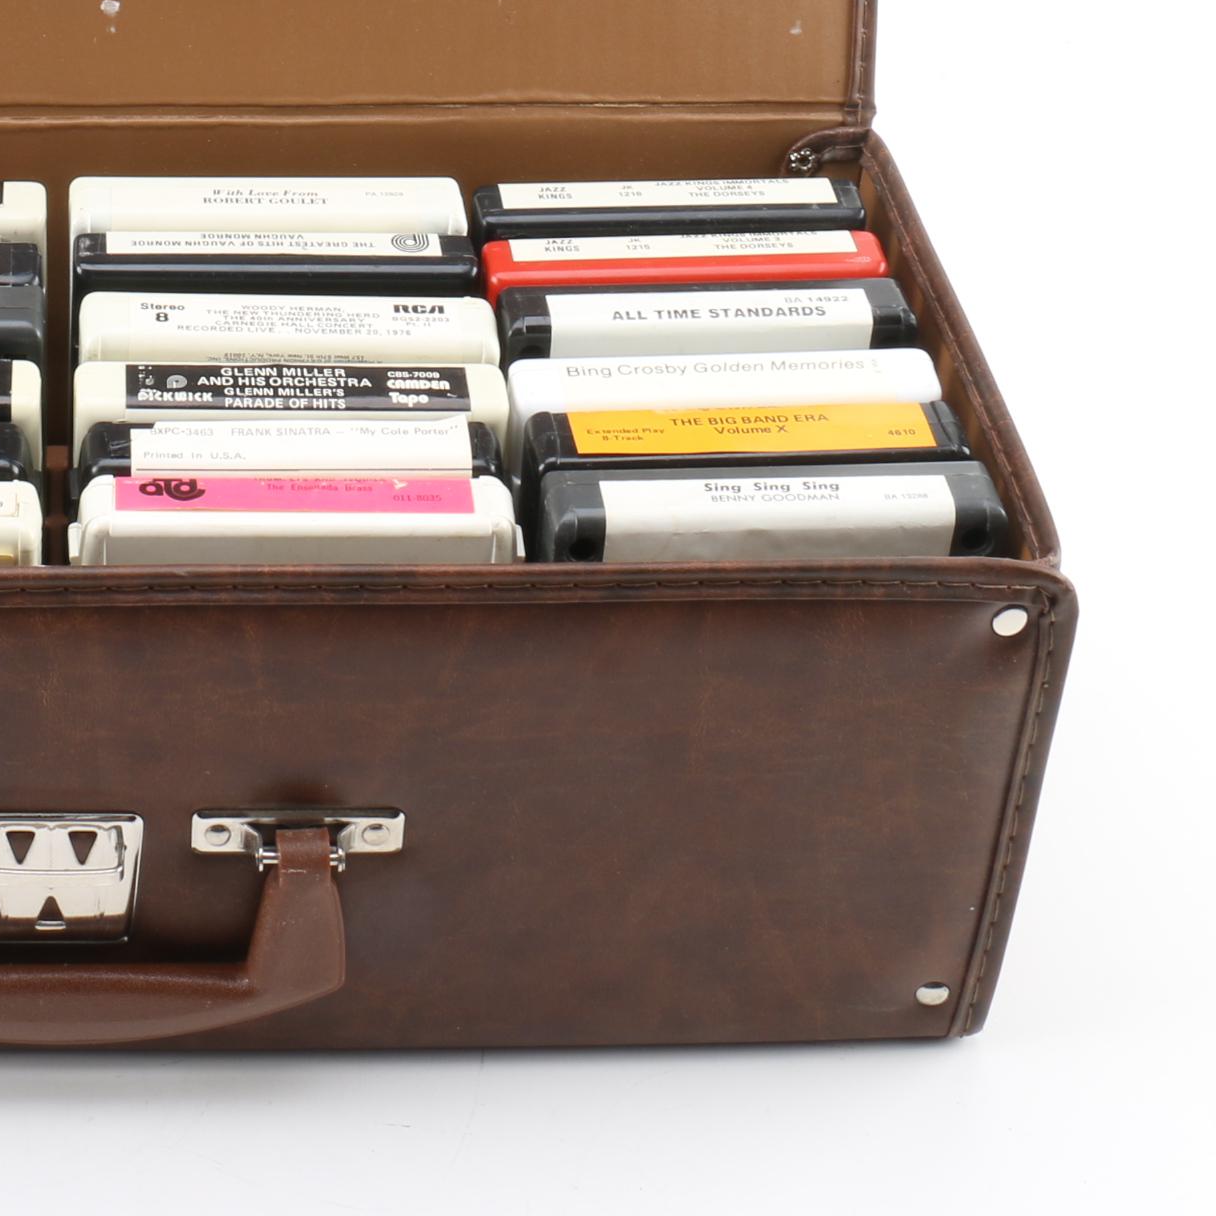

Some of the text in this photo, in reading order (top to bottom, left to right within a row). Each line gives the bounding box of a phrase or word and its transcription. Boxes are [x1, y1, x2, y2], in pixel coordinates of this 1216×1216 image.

[248, 189, 279, 197] Love
[283, 189, 319, 197] From
[269, 197, 329, 205] GOULET
[544, 245, 580, 253] KINGS
[140, 302, 185, 311] Stereo
[393, 304, 445, 314] RCA
[155, 312, 169, 322] 8
[612, 306, 827, 321] ALL TIME STANDARDS
[177, 325, 244, 333] RECORDED
[294, 327, 363, 335] NOVEMBER
[220, 367, 346, 377] GLENN MILLER
[566, 366, 612, 378] Bing
[617, 364, 687, 377] Crosby
[693, 361, 765, 374] Golden
[770, 358, 865, 372] Memories
[197, 376, 373, 387] AND HIS ORCHESTRA
[386, 379, 450, 390] CAMDEN
[224, 387, 345, 397] GLENN MILLER'S
[224, 397, 346, 409] PARADE OF HITS
[388, 392, 430, 407] Tape
[670, 414, 830, 427] THE BIG BAND ERA
[231, 427, 272, 437] FRANK
[276, 427, 331, 436] SINATRA
[381, 427, 409, 436] Cole
[714, 425, 789, 435] Volume X
[143, 451, 184, 460] Printed
[704, 481, 841, 494] Sing Sing Sing
[711, 493, 841, 503] BENNY GOODMAN
